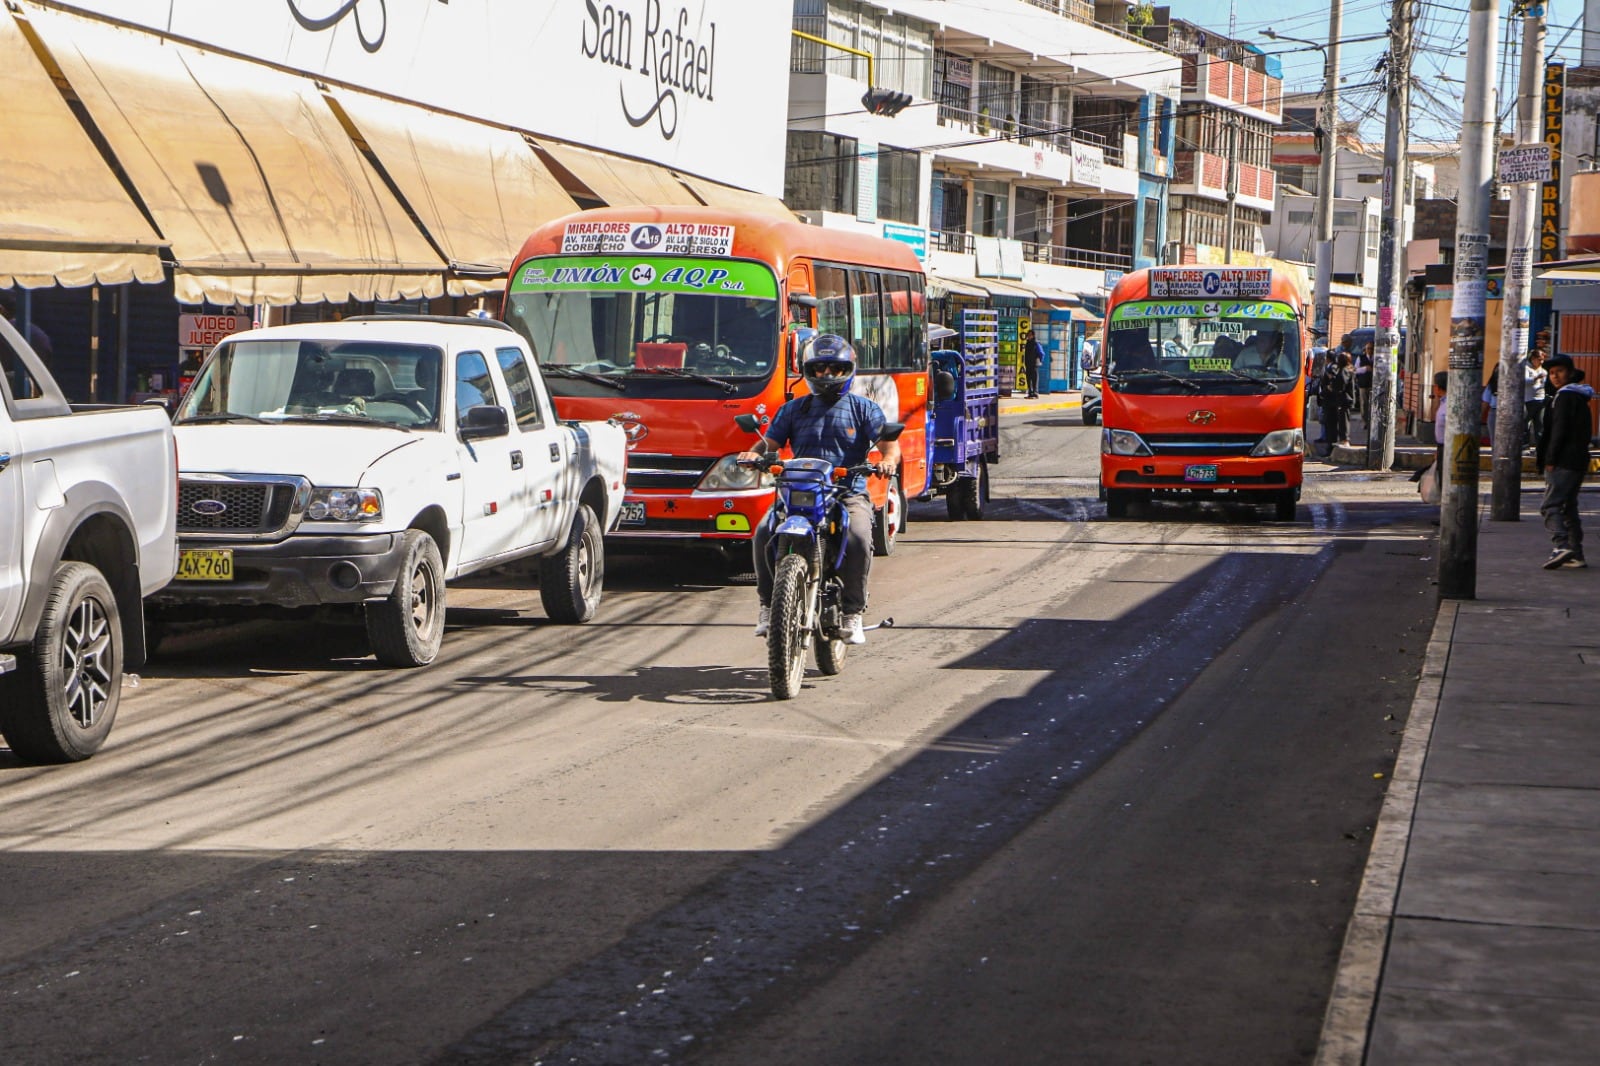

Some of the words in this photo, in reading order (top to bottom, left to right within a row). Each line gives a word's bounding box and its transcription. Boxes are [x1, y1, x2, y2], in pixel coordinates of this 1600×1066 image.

[581, 0, 632, 70] San
[620, 0, 716, 141] Rafael
[1500, 146, 1549, 158] MAESTRO
[1501, 169, 1550, 183] 921804177
[567, 223, 631, 235] MIRAFLORES
[665, 224, 695, 235] ALTO
[699, 225, 730, 237] MISTI
[581, 235, 627, 243] TARAPACA
[676, 236, 685, 245] LA
[699, 237, 718, 246] SIGLO
[719, 238, 729, 247] XX
[564, 243, 625, 252] CORBACHO
[665, 244, 726, 255] PROGRESO
[551, 263, 626, 284] UNIÓN
[631, 267, 653, 281] C-4
[660, 267, 729, 289] AQP
[1153, 270, 1204, 282] MIRAFLORES
[1220, 270, 1242, 281] ALTO
[1245, 270, 1271, 282] MISTI
[1203, 303, 1219, 314] C-4
[194, 316, 236, 331] VIDEO
[1203, 322, 1242, 333] TOMASA
[178, 558, 230, 576] Z4X-760
